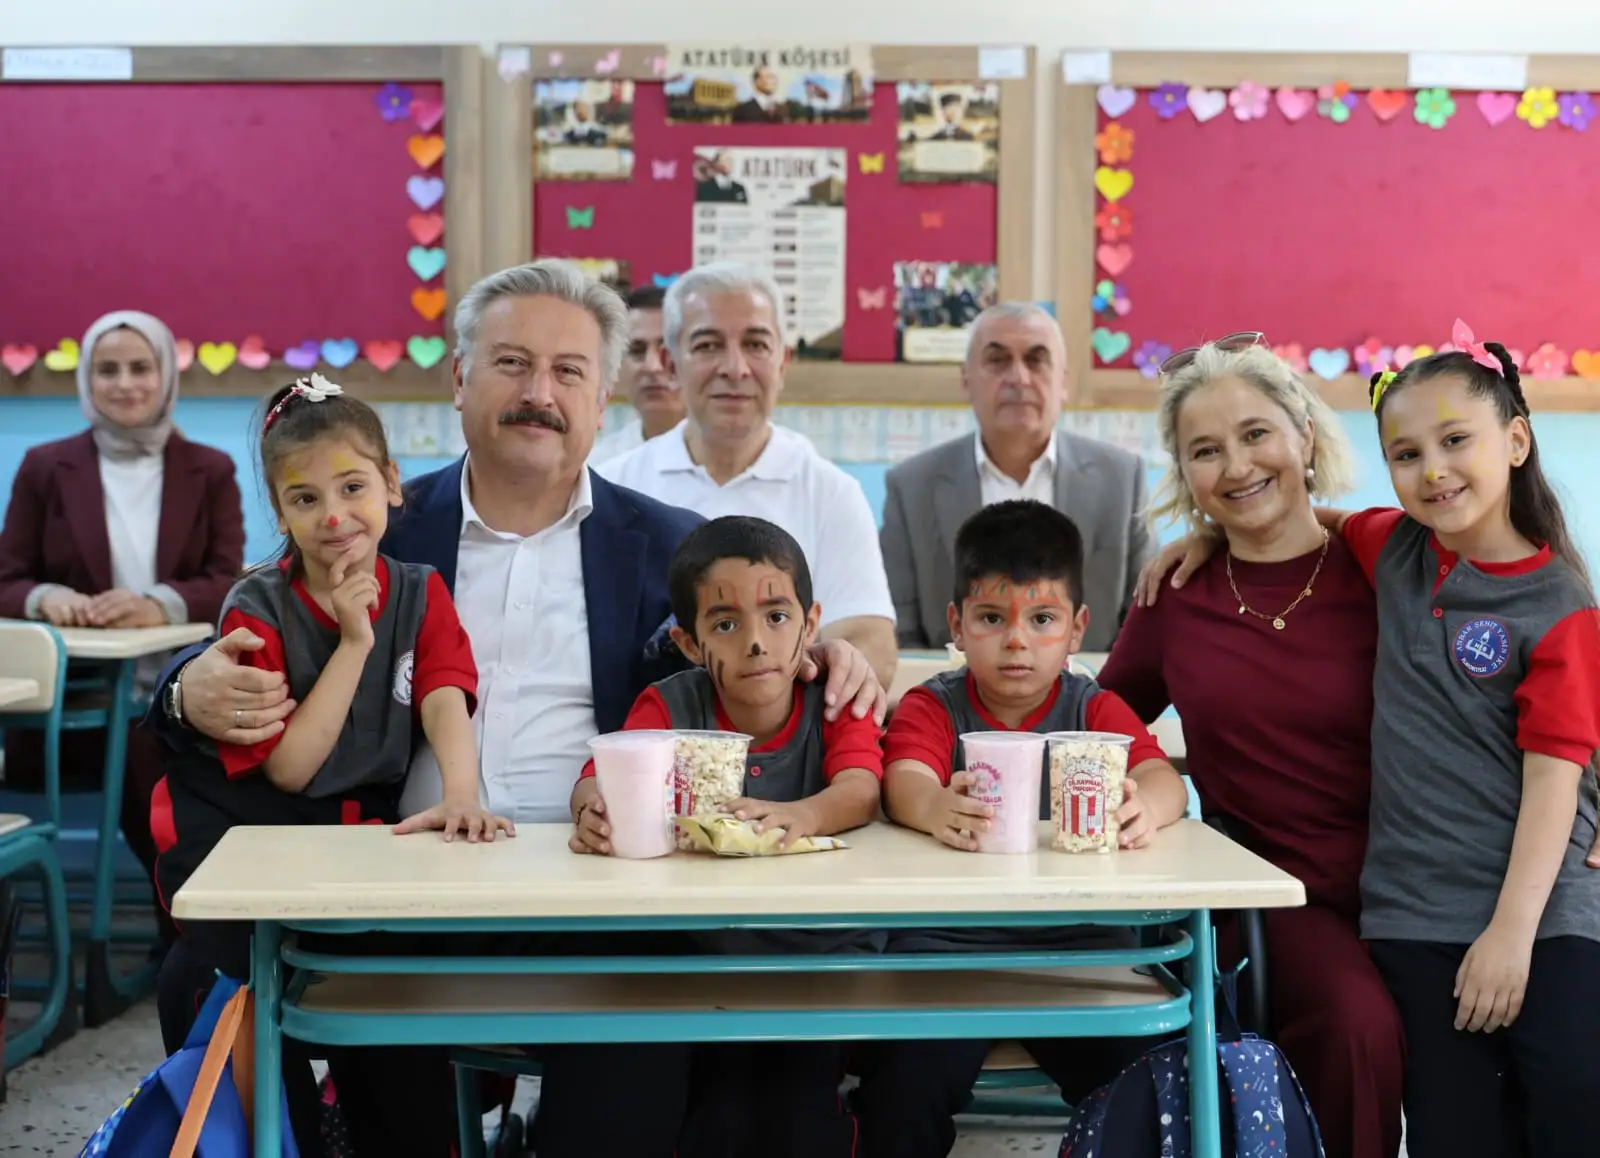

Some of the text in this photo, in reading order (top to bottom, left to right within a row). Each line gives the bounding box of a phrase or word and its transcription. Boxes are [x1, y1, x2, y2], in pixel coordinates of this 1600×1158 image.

[682, 46, 850, 72] ATATÜRK KÖŞESİ
[742, 155, 817, 178] ATATÜRK
